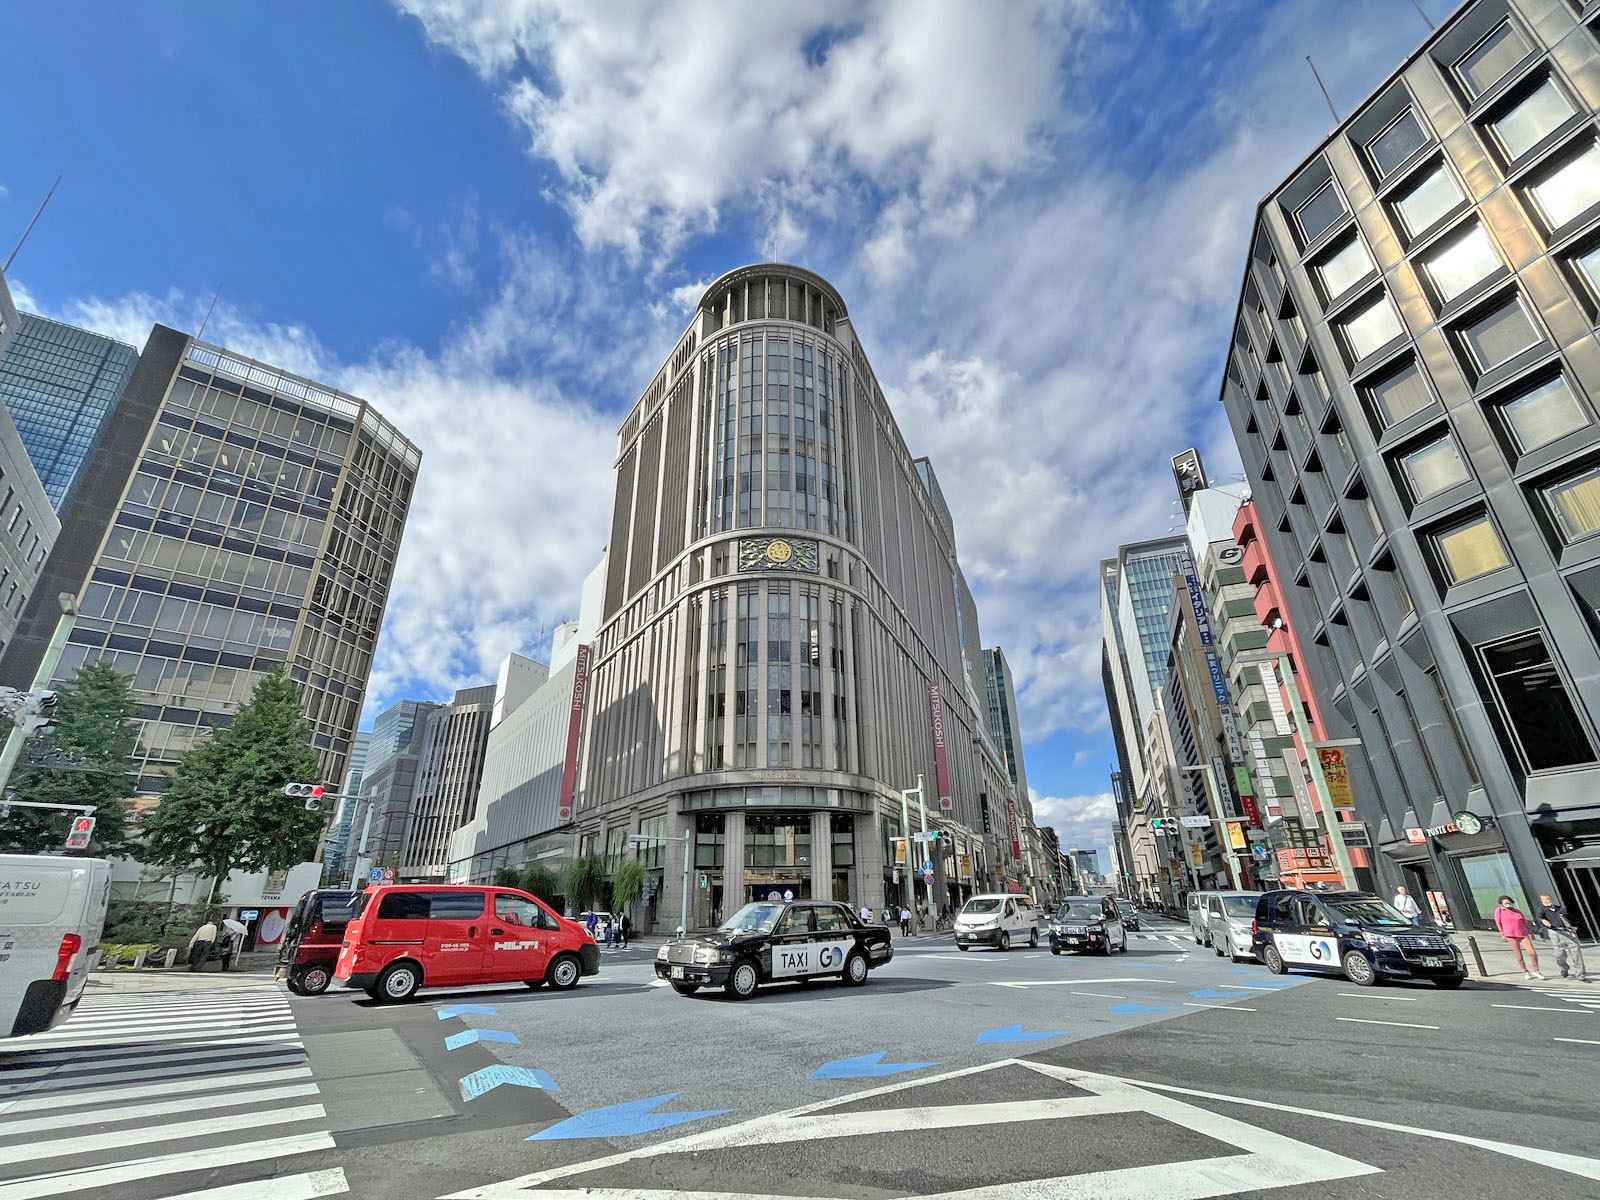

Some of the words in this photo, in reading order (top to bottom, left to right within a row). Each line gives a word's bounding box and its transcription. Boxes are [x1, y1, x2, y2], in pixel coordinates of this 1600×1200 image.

[1178, 459, 1199, 492] 天野
[573, 648, 587, 711] MITSUKOSHI
[931, 686, 944, 748] MITSUKOSHI
[752, 771, 807, 780] MITSUKOSHI
[1008, 802, 1018, 842] MITSUKOSHI
[1426, 825, 1447, 838] PONTE
[1446, 823, 1459, 833] CE
[0, 882, 41, 890] ATSU
[494, 941, 539, 951] HILTI
[781, 952, 808, 968] TAXI
